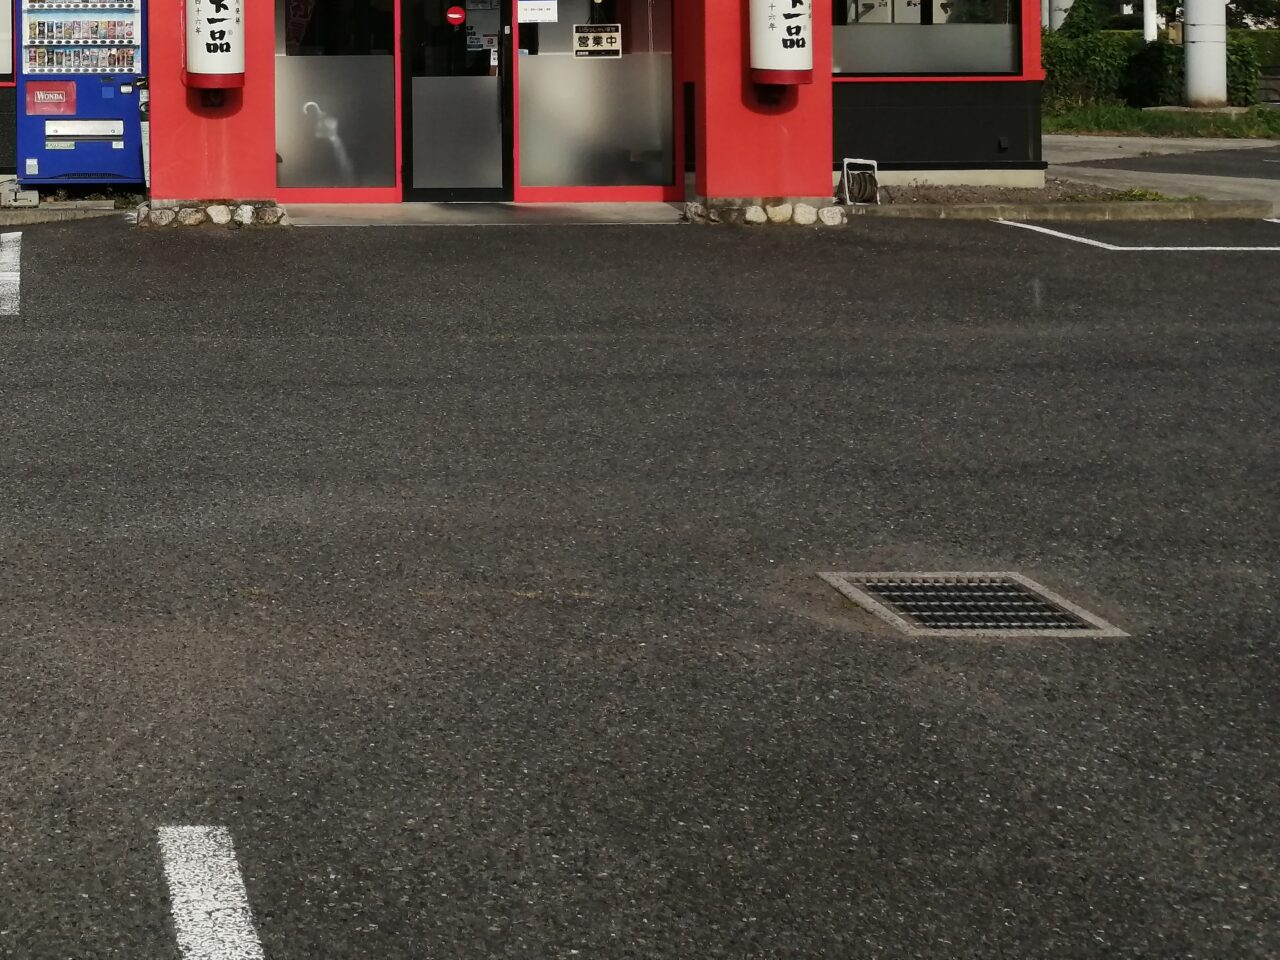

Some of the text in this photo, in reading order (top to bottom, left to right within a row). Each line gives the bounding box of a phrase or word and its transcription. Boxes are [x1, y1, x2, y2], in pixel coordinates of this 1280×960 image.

[578, 35, 617, 48] 営業中
[36, 91, 64, 101] WONDA
